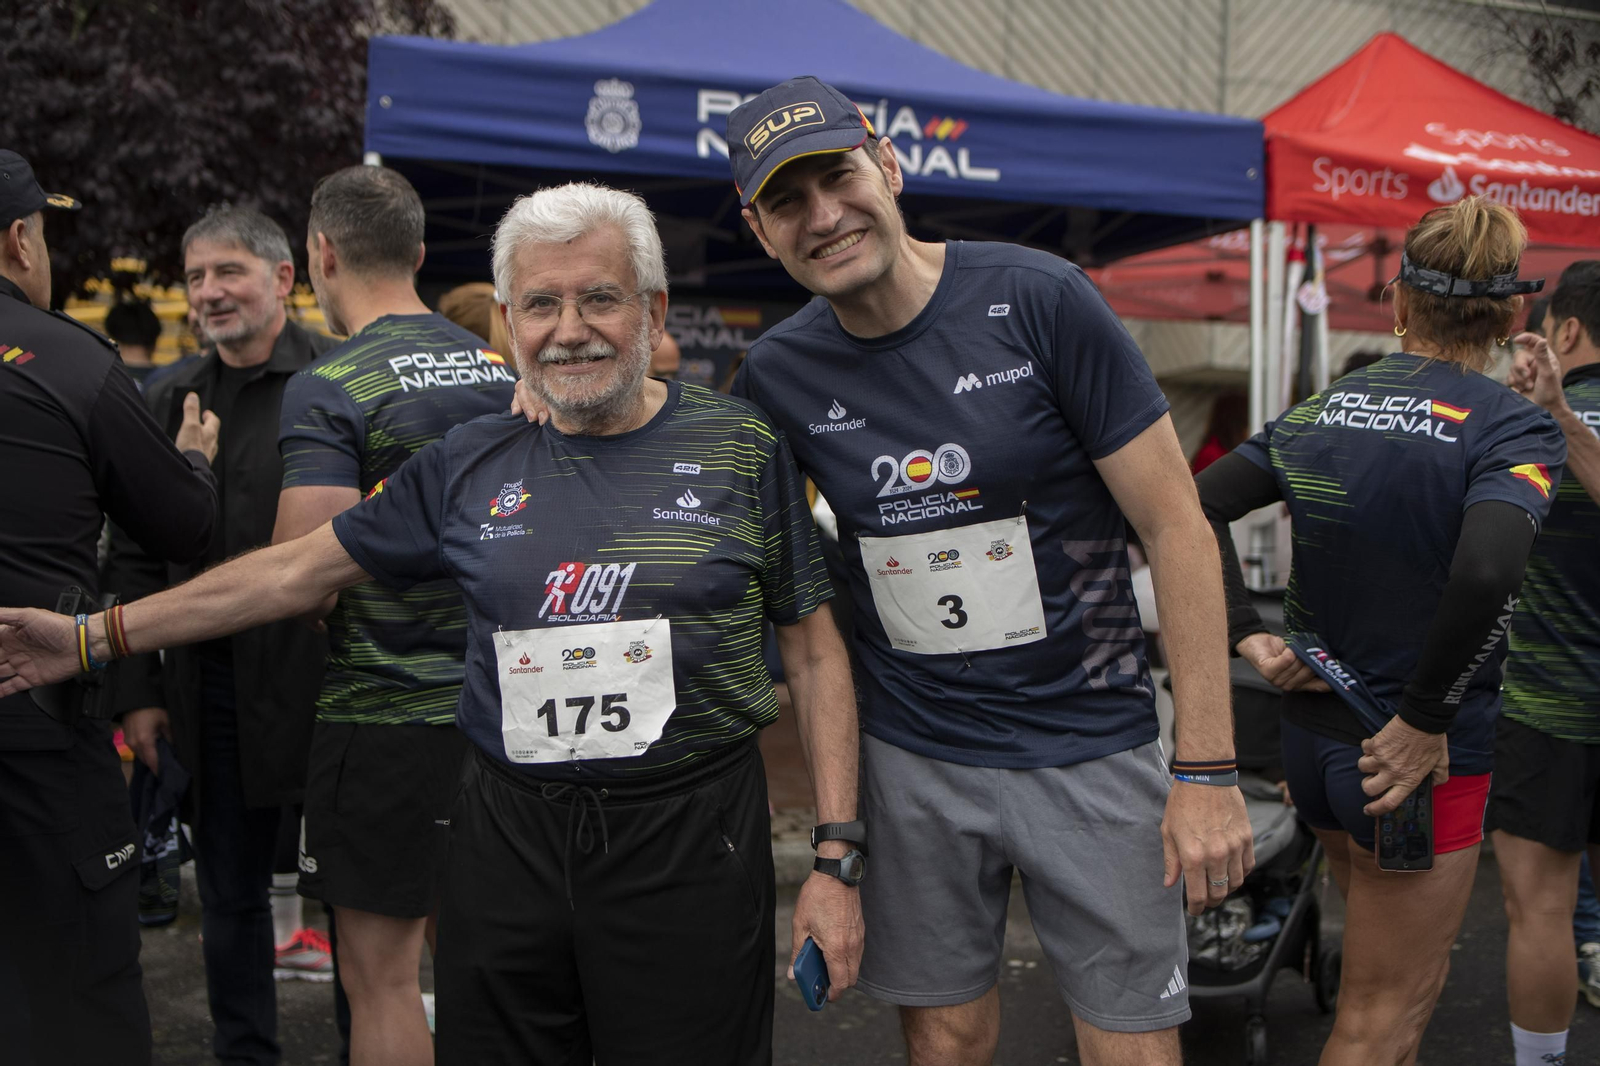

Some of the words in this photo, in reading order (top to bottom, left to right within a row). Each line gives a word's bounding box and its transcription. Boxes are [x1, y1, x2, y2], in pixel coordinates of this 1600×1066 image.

[749, 105, 817, 151] SUP
[1312, 156, 1409, 201] Sports
[399, 366, 517, 392] NACIONAL
[986, 361, 1034, 386] mupol
[808, 418, 866, 435] Santander
[1314, 409, 1458, 443] NACIONAL
[871, 442, 971, 498] 200
[652, 507, 721, 526] Santander
[881, 500, 984, 526] NACIONAL
[480, 523, 494, 540] 75
[877, 567, 913, 576] Santander
[547, 614, 618, 622] SOLIDARIA
[937, 594, 968, 629] 3
[509, 666, 544, 675] Santander
[537, 693, 631, 738] 175
[105, 843, 135, 870] CNP
